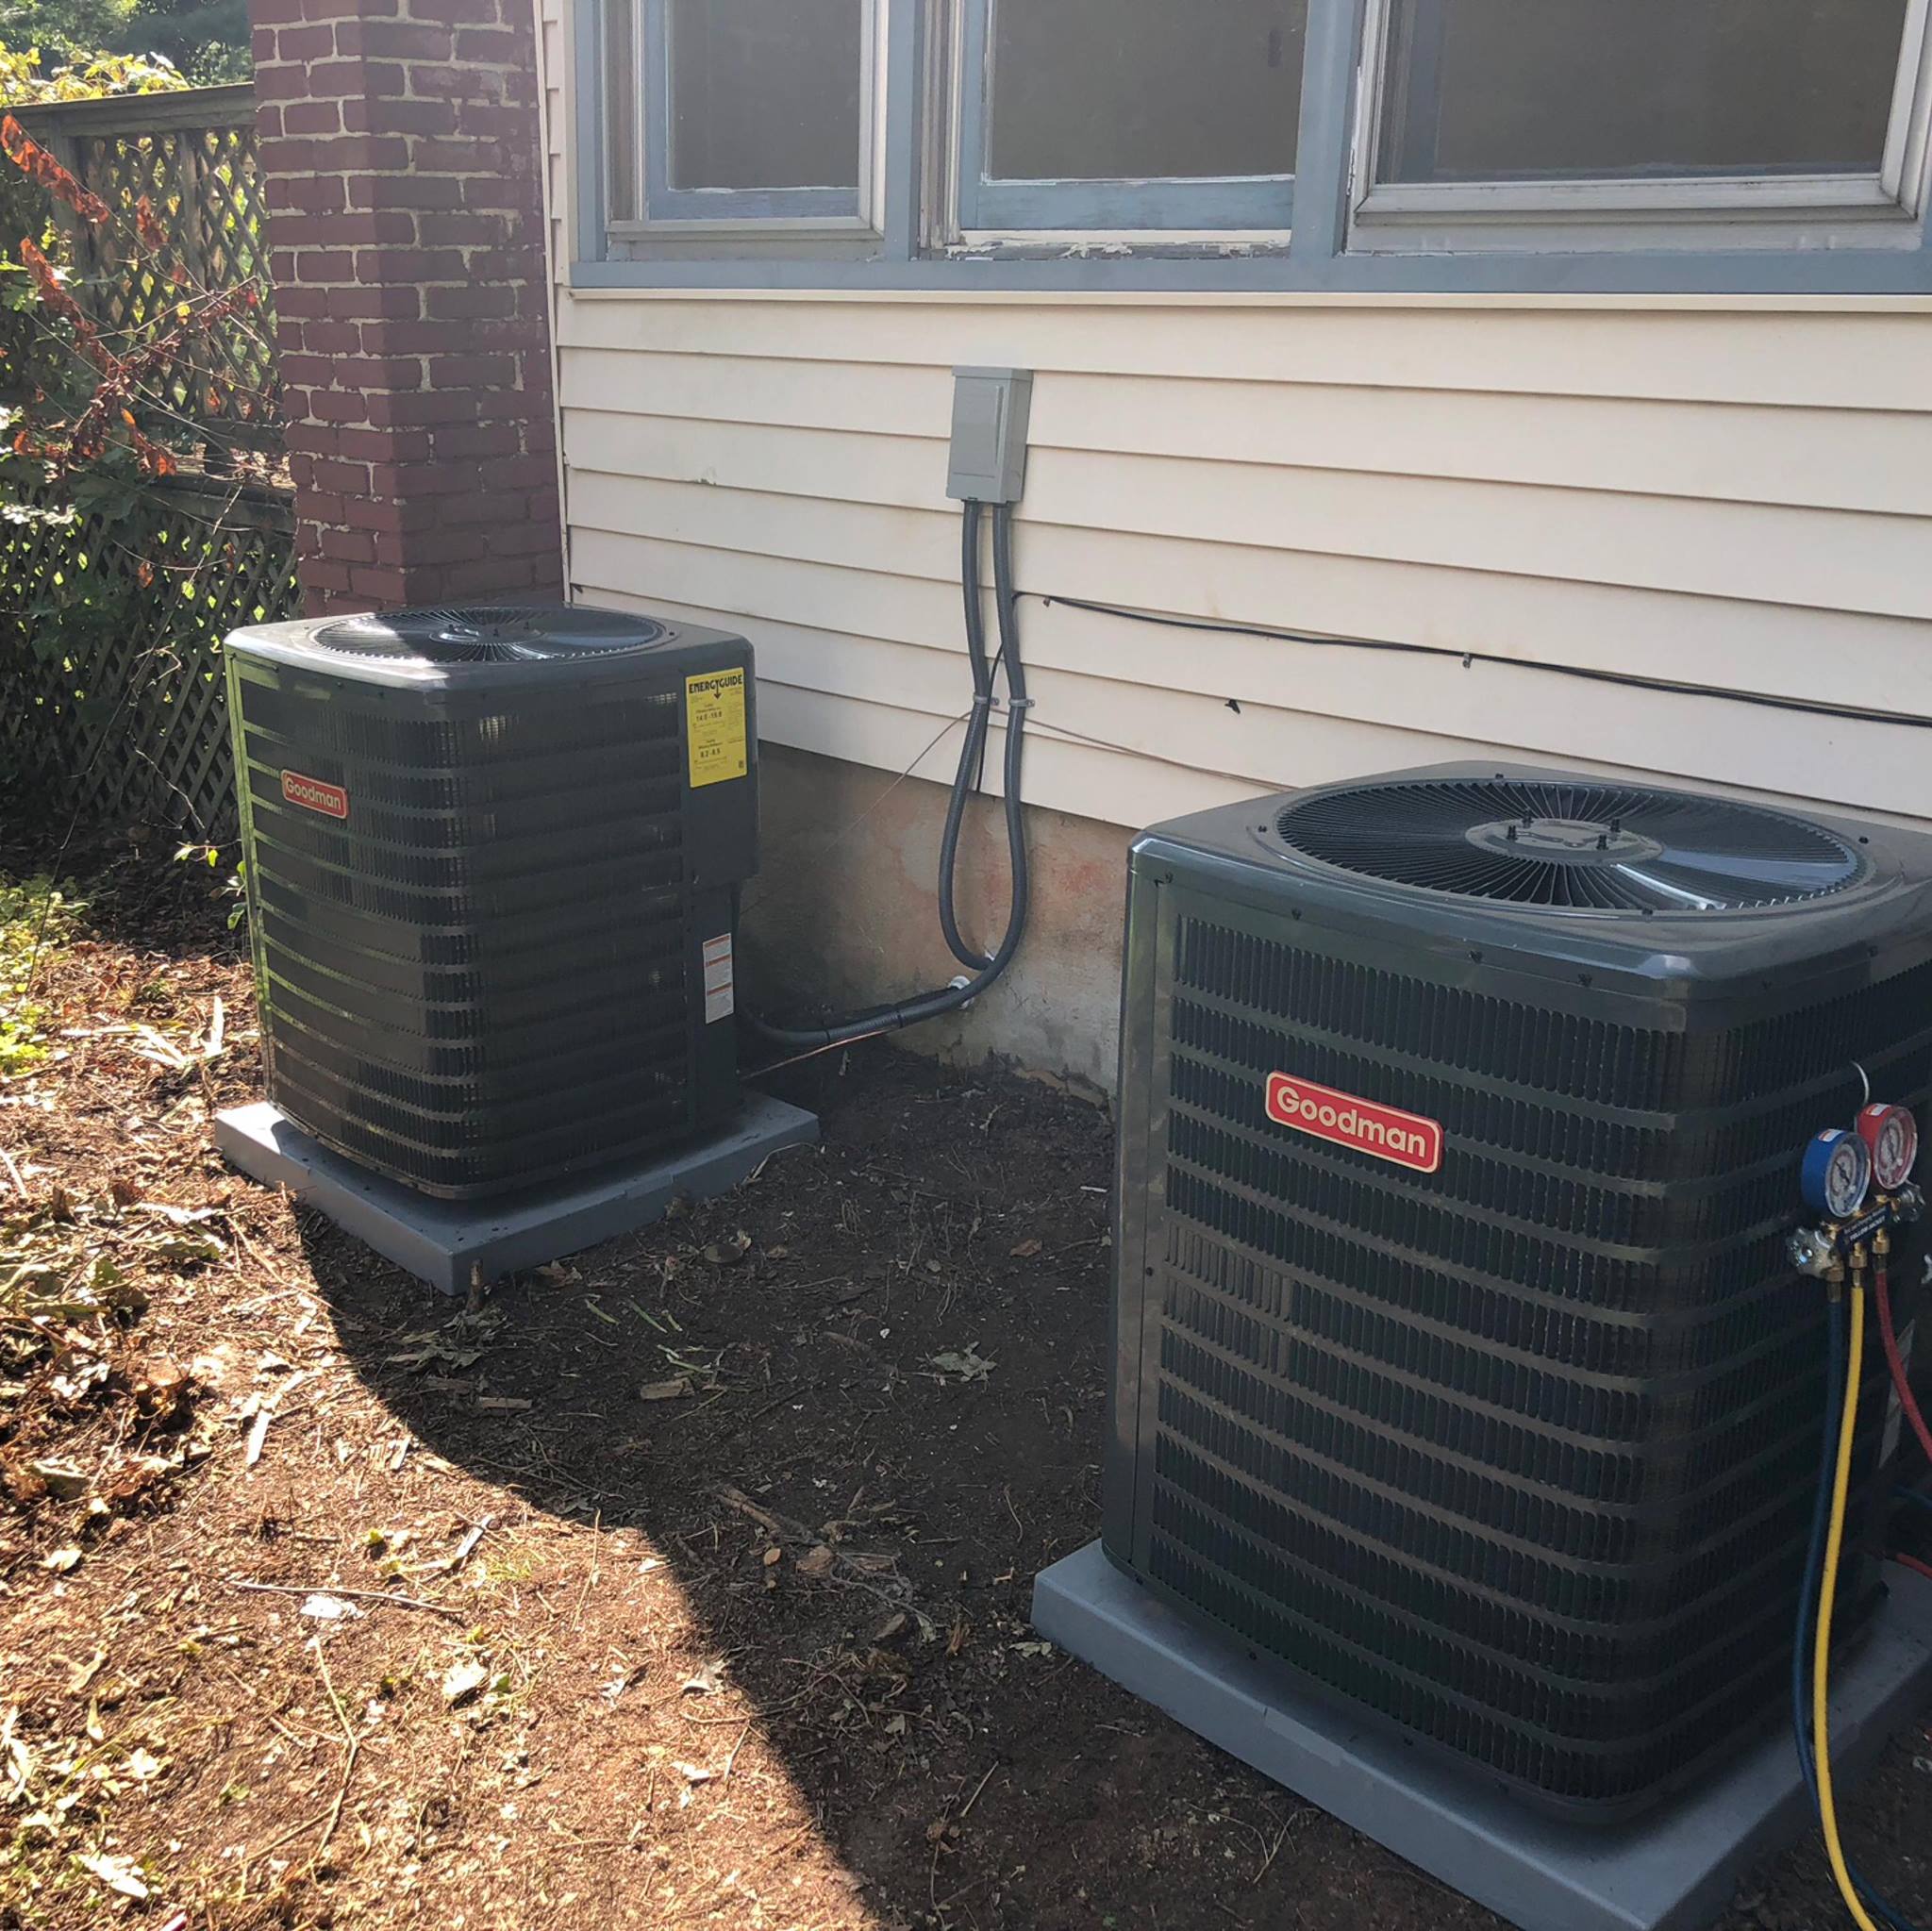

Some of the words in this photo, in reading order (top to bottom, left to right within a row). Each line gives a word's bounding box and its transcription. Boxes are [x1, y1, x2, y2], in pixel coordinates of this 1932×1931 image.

[689, 674, 742, 694] ENERGYGUIDE
[286, 777, 341, 810] Goodman
[1276, 1086, 1425, 1157] Goodman
